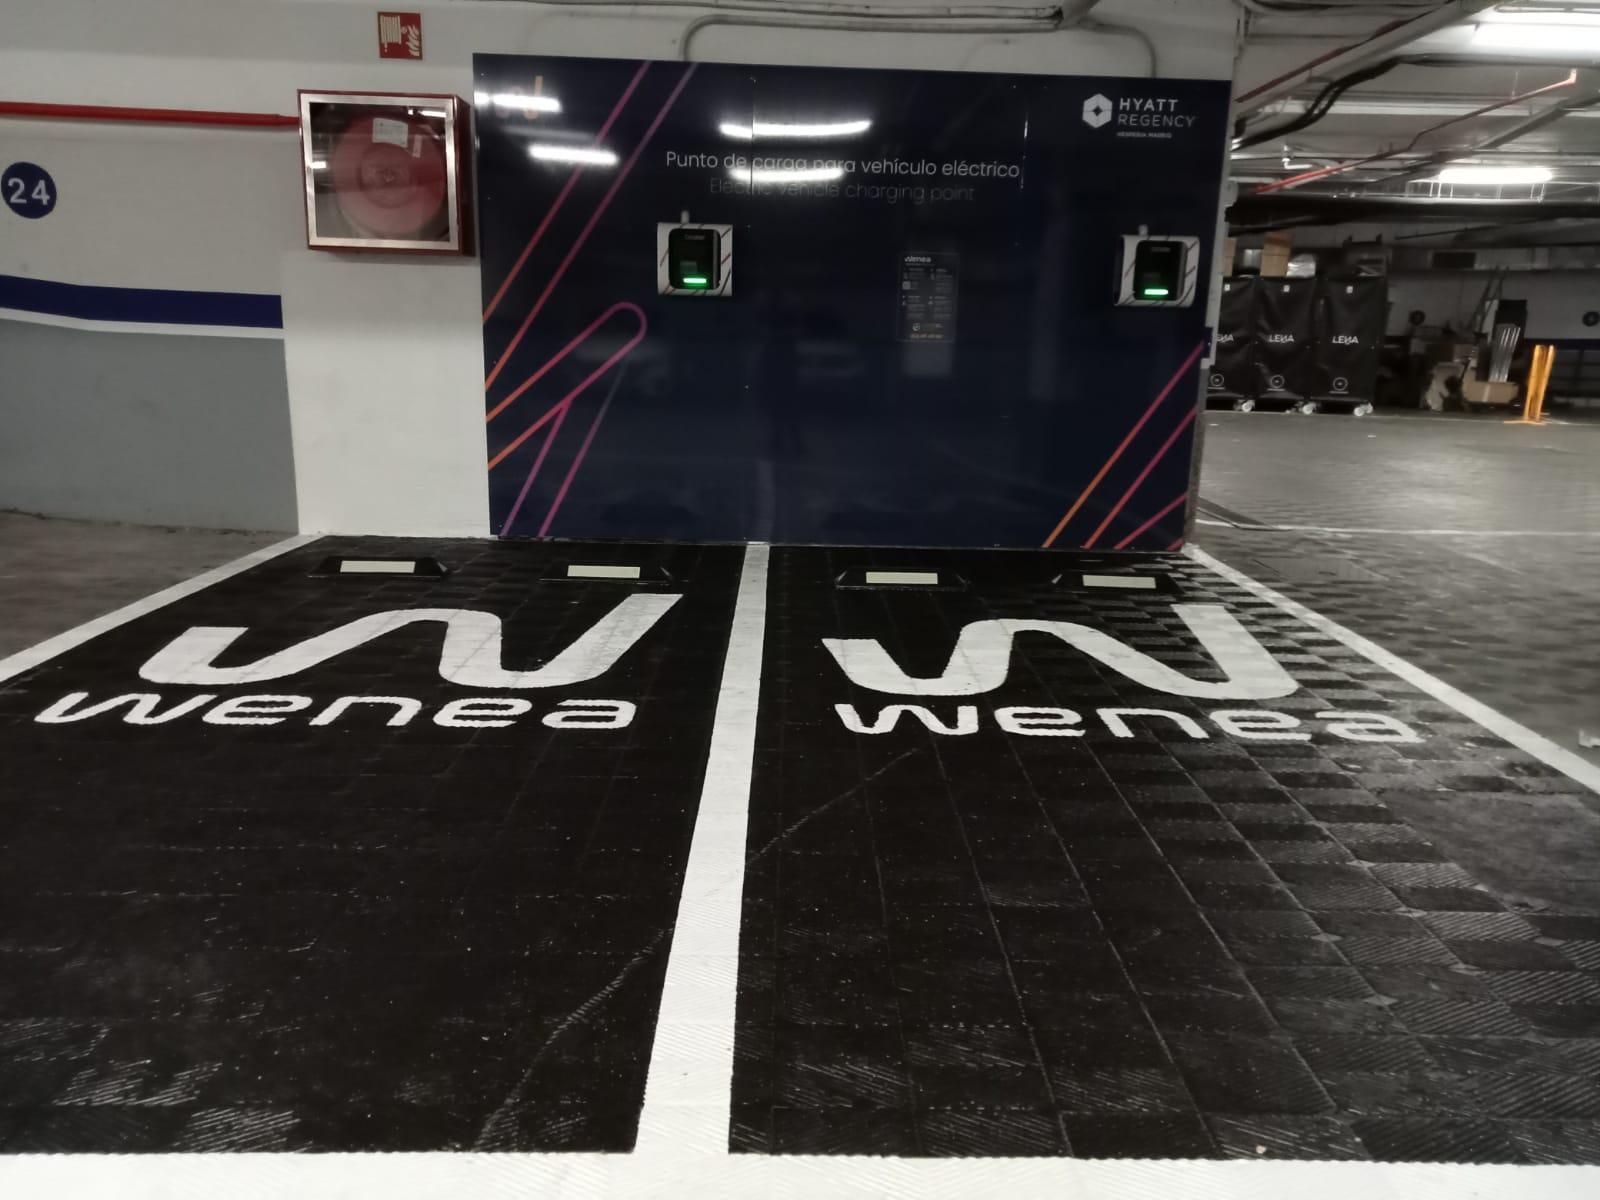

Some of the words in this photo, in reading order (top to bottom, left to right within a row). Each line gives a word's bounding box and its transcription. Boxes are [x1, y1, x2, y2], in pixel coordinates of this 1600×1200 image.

[1119, 97, 1178, 112] HYATT
[1118, 113, 1196, 128] REGENCY
[666, 151, 719, 169] Punto
[723, 153, 747, 170] de
[752, 157, 808, 173] carga
[813, 159, 856, 175] para
[861, 158, 937, 176] vehículo
[941, 160, 1020, 178] eléctrico
[8, 178, 50, 205] 24
[846, 184, 925, 205] charging
[930, 186, 975, 205] point
[34, 692, 637, 730] wenea
[834, 702, 1424, 744] wenea
